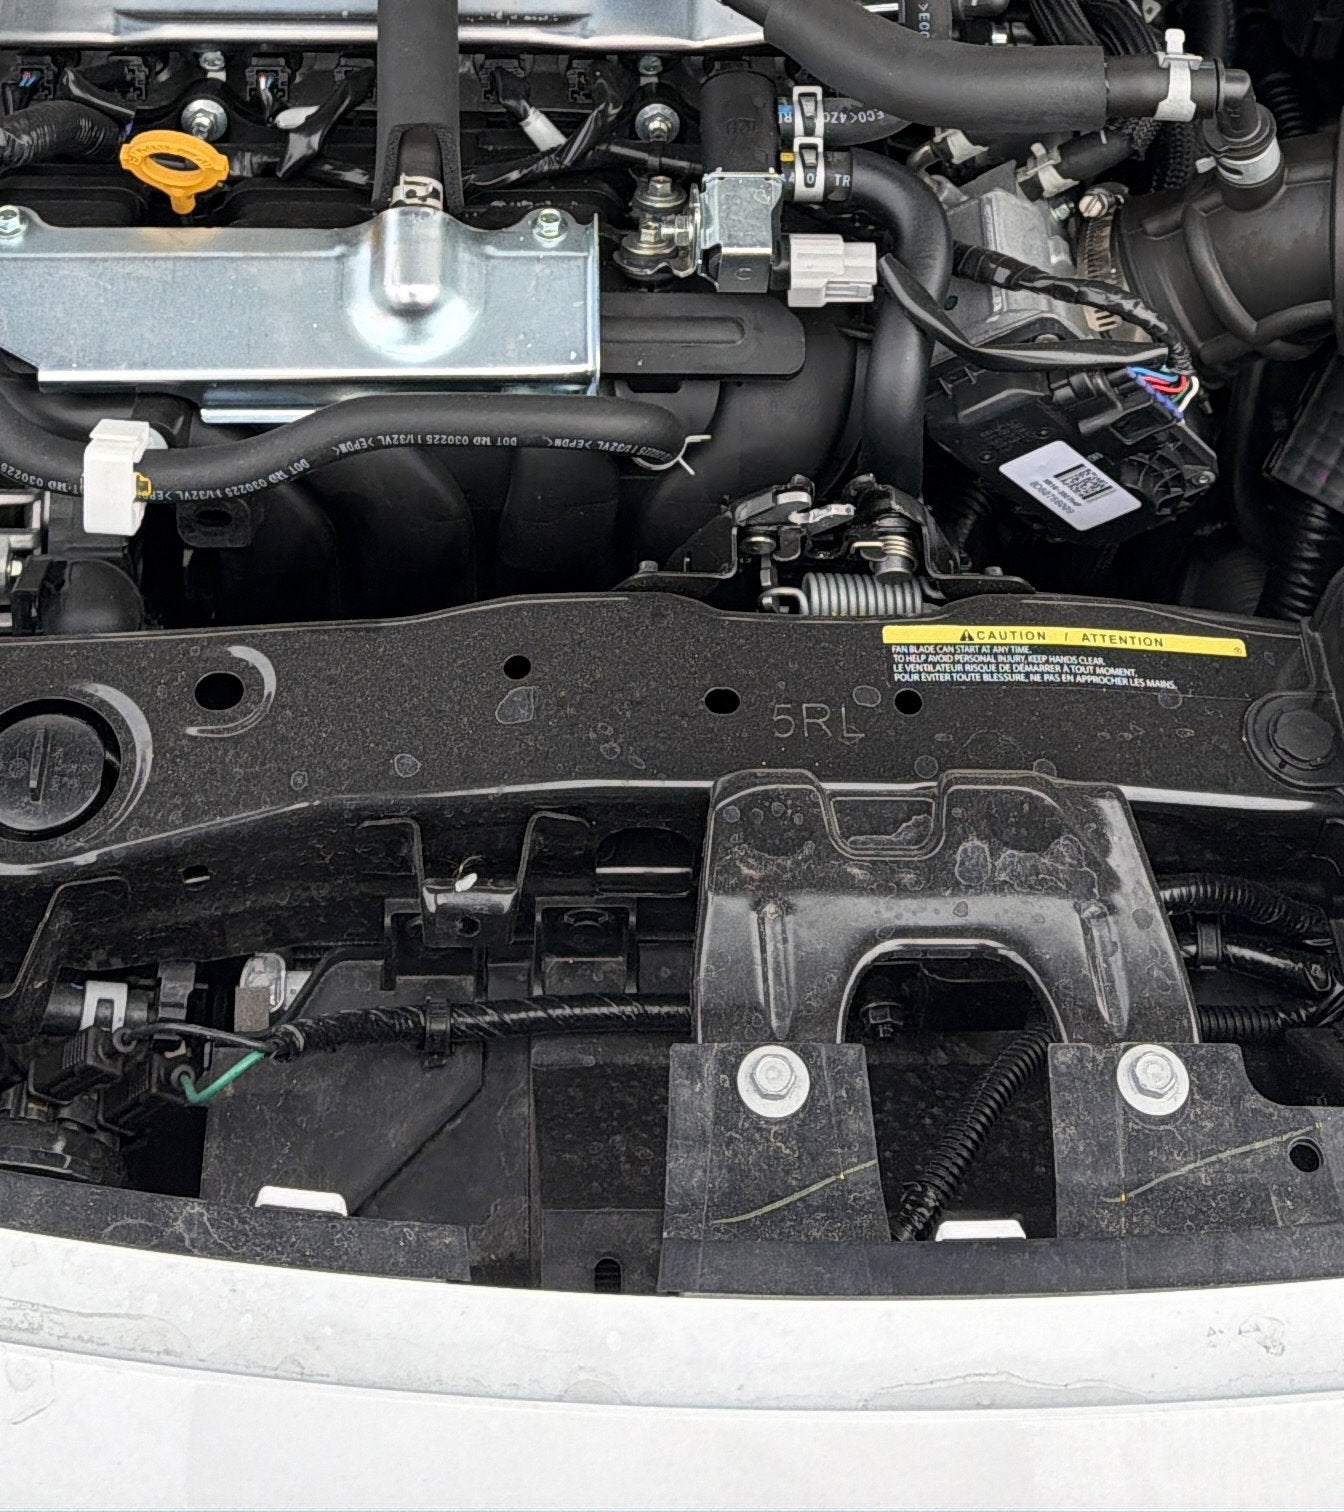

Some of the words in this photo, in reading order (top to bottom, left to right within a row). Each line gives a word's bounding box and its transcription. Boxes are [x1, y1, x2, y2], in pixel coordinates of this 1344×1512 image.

[977, 630, 1046, 641] CAUTION
[1082, 633, 1164, 647] ATTENTION
[891, 645, 907, 653] FAN
[909, 645, 935, 653] BLADE
[937, 645, 954, 653] CAN
[956, 645, 980, 654] START
[981, 645, 991, 653] AT
[993, 645, 1009, 653] ANY
[1011, 645, 1032, 654] TIME.
[928, 654, 953, 662] AVOID
[955, 655, 996, 663] PERSONAL
[1028, 655, 1047, 663] KEEP
[1049, 655, 1078, 664] HANDS
[1079, 656, 1105, 665] CLEAR.
[893, 664, 905, 672] LE
[906, 664, 963, 672] VENTILATEUR
[965, 664, 997, 673] RISQUE
[999, 664, 1011, 672] DE
[1013, 663, 1061, 673] DÉMARRER
[1062, 663, 1069, 673] À
[1070, 665, 1094, 674] TOUT
[1096, 667, 1138, 677] MOMENT.
[894, 673, 919, 681] POUR
[921, 672, 950, 681] ÉVITER
[952, 673, 981, 681] TOUTE
[1030, 674, 1043, 682] NE
[1044, 674, 1060, 682] PAS
[1062, 674, 1074, 682] EN
[1076, 675, 1129, 686] APPROCHER
[1130, 678, 1145, 688] LES
[1147, 679, 1178, 689] MAINS.
[773, 703, 865, 737] 5RL
